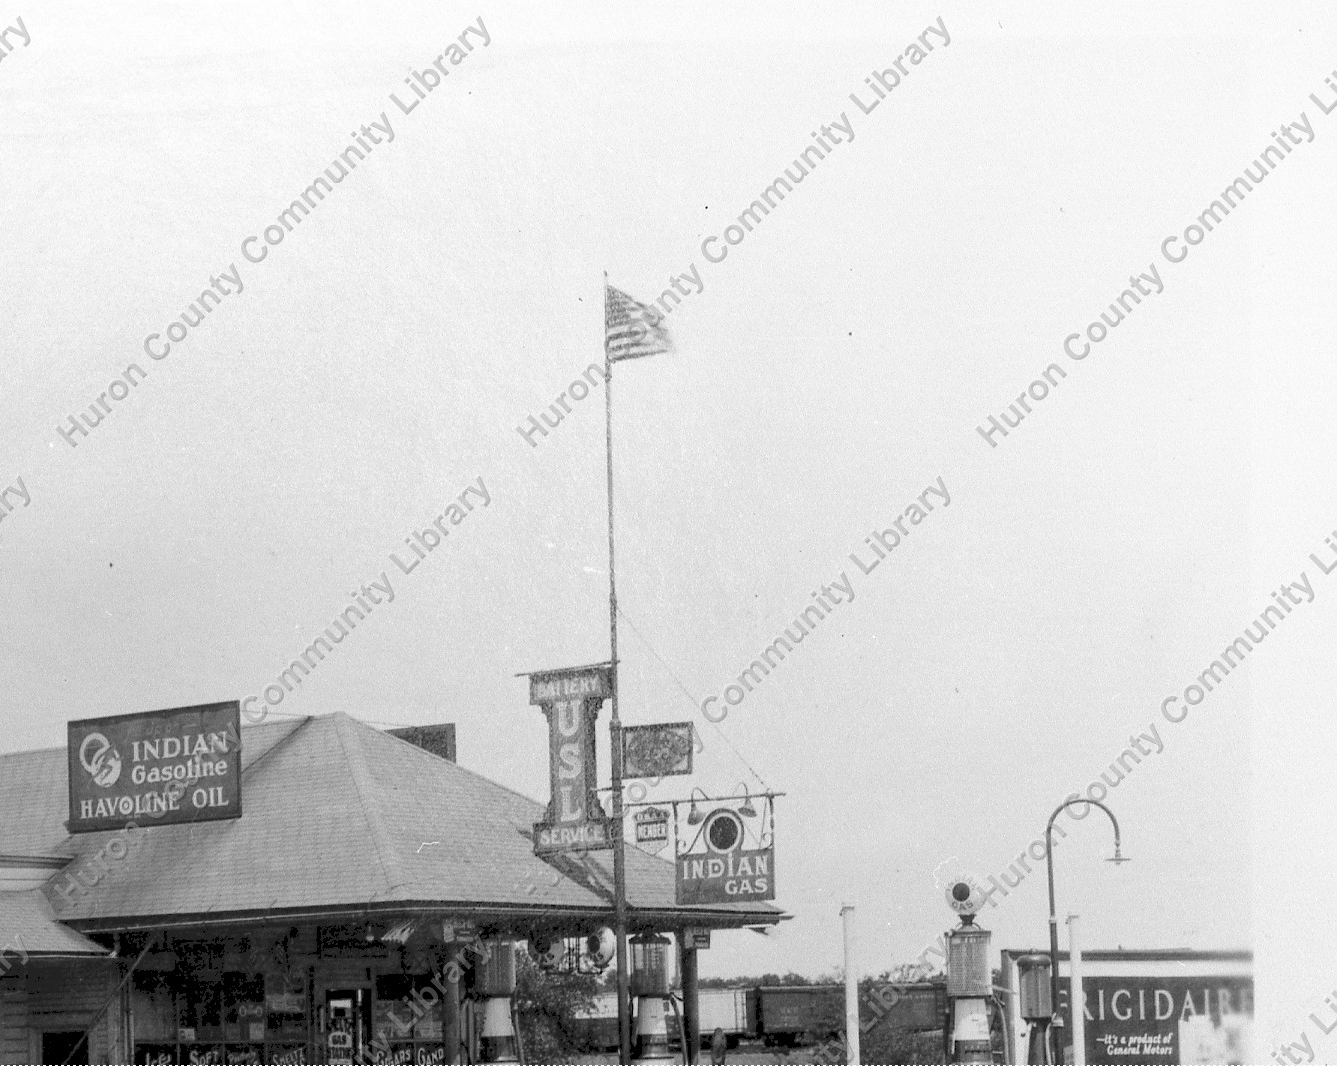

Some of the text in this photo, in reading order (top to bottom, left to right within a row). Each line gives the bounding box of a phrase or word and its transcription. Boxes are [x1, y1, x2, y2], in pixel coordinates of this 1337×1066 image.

[132, 731, 228, 762] INDIAN
[132, 756, 228, 784] Gasoline
[80, 786, 229, 819] HAVOLINE OIL
[539, 823, 604, 846] SERVICE
[682, 854, 769, 880] INDIAN
[724, 877, 769, 894] GAS
[1107, 1043, 1173, 1055] General Motors
[1128, 1033, 1162, 1047] product
[1163, 1032, 1173, 1044] of
